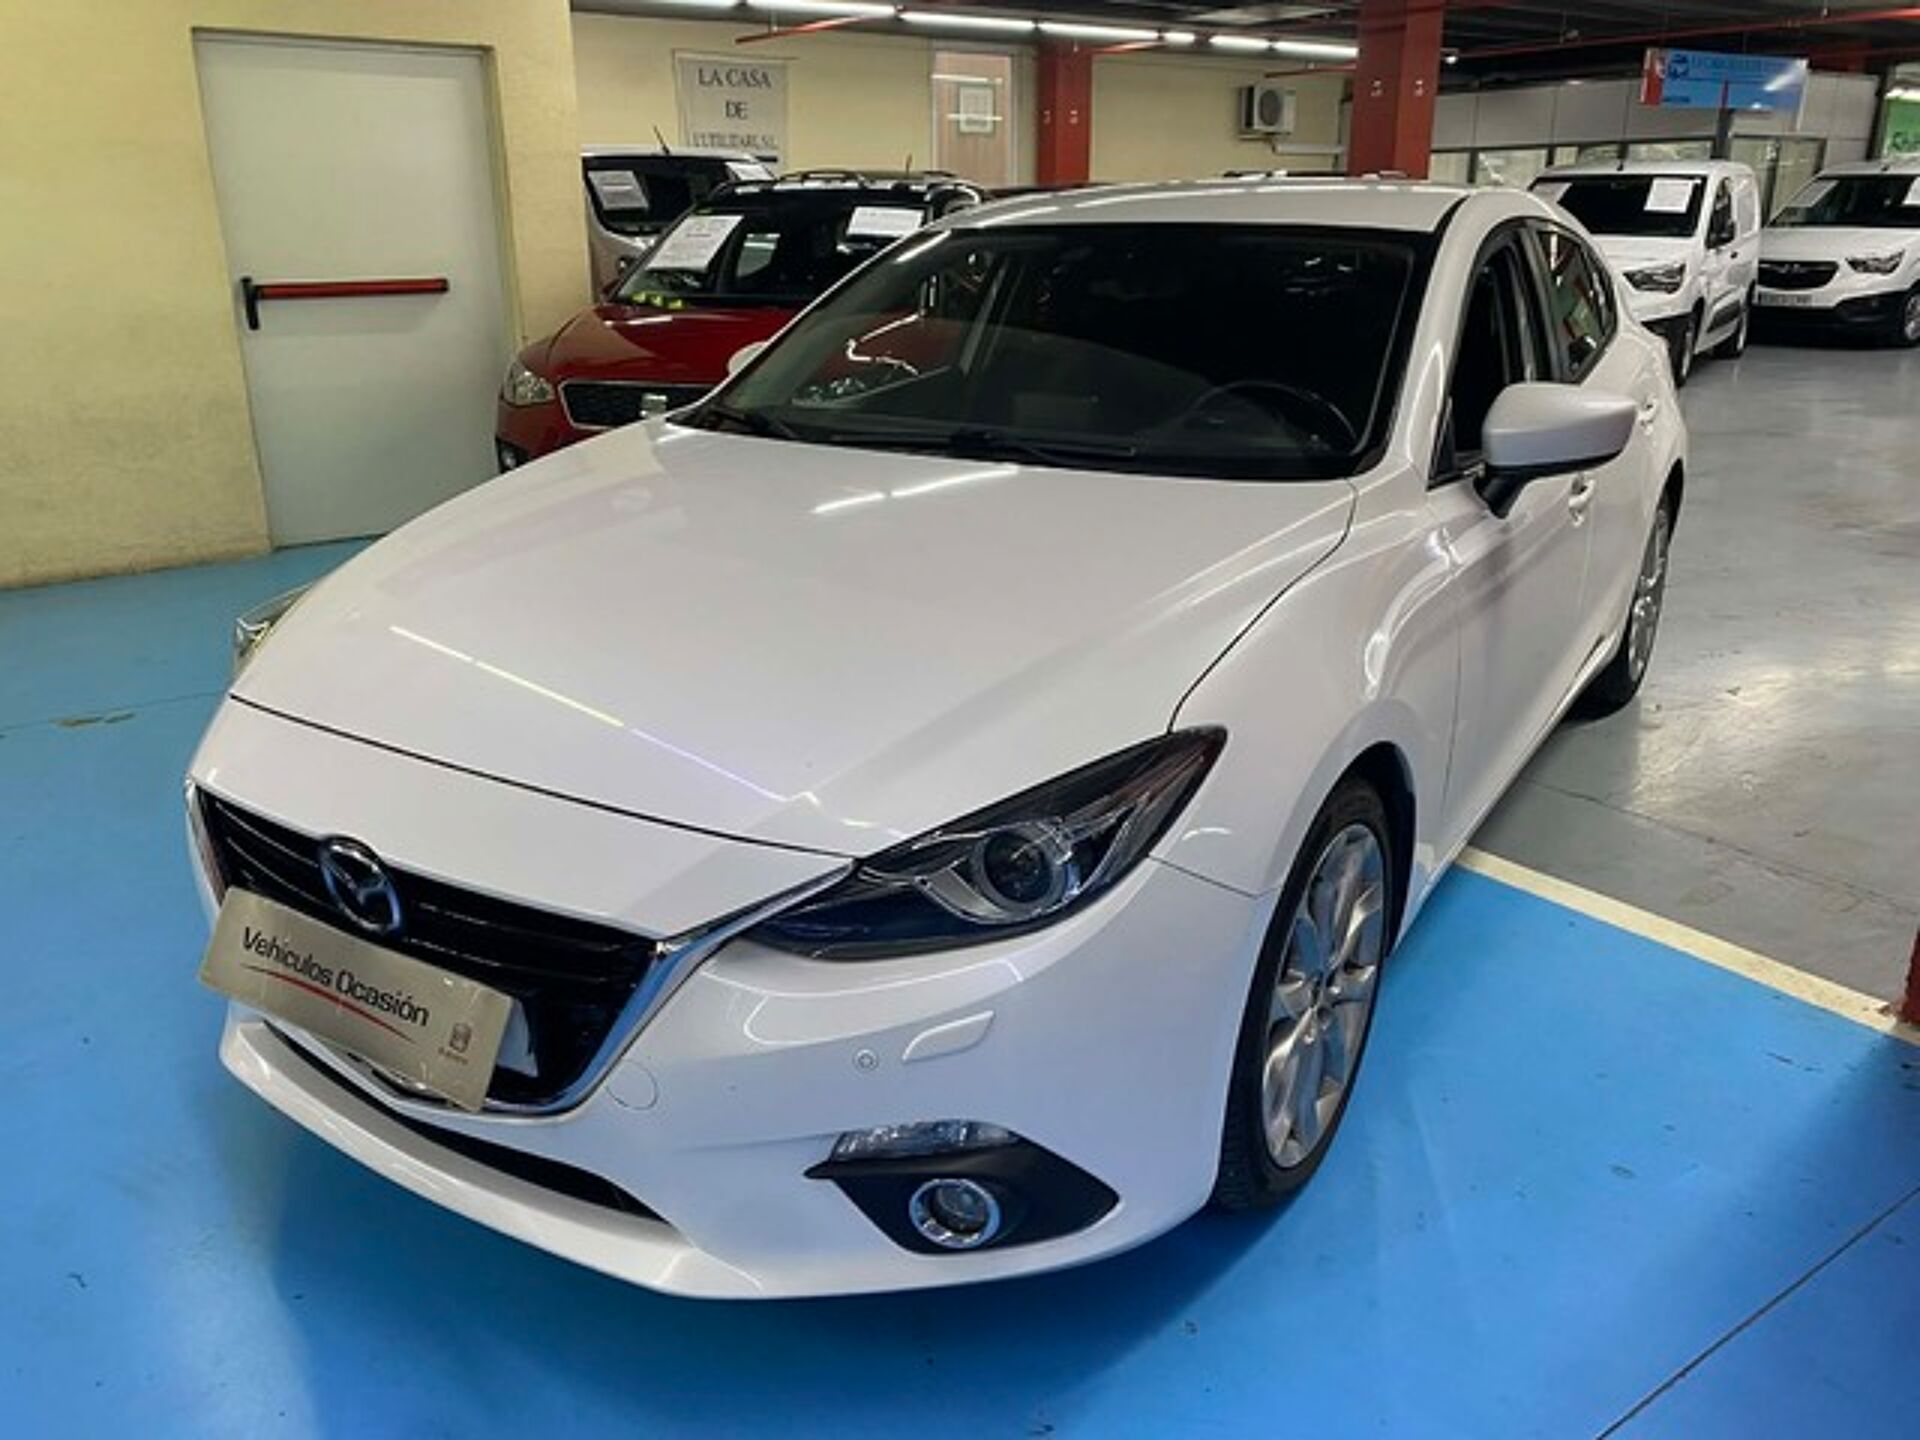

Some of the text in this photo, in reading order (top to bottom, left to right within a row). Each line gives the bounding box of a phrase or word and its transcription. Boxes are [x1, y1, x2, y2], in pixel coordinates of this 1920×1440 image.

[698, 67, 772, 88] LA CASA
[726, 100, 749, 120] DE
[336, 970, 429, 1026] Ocasión
